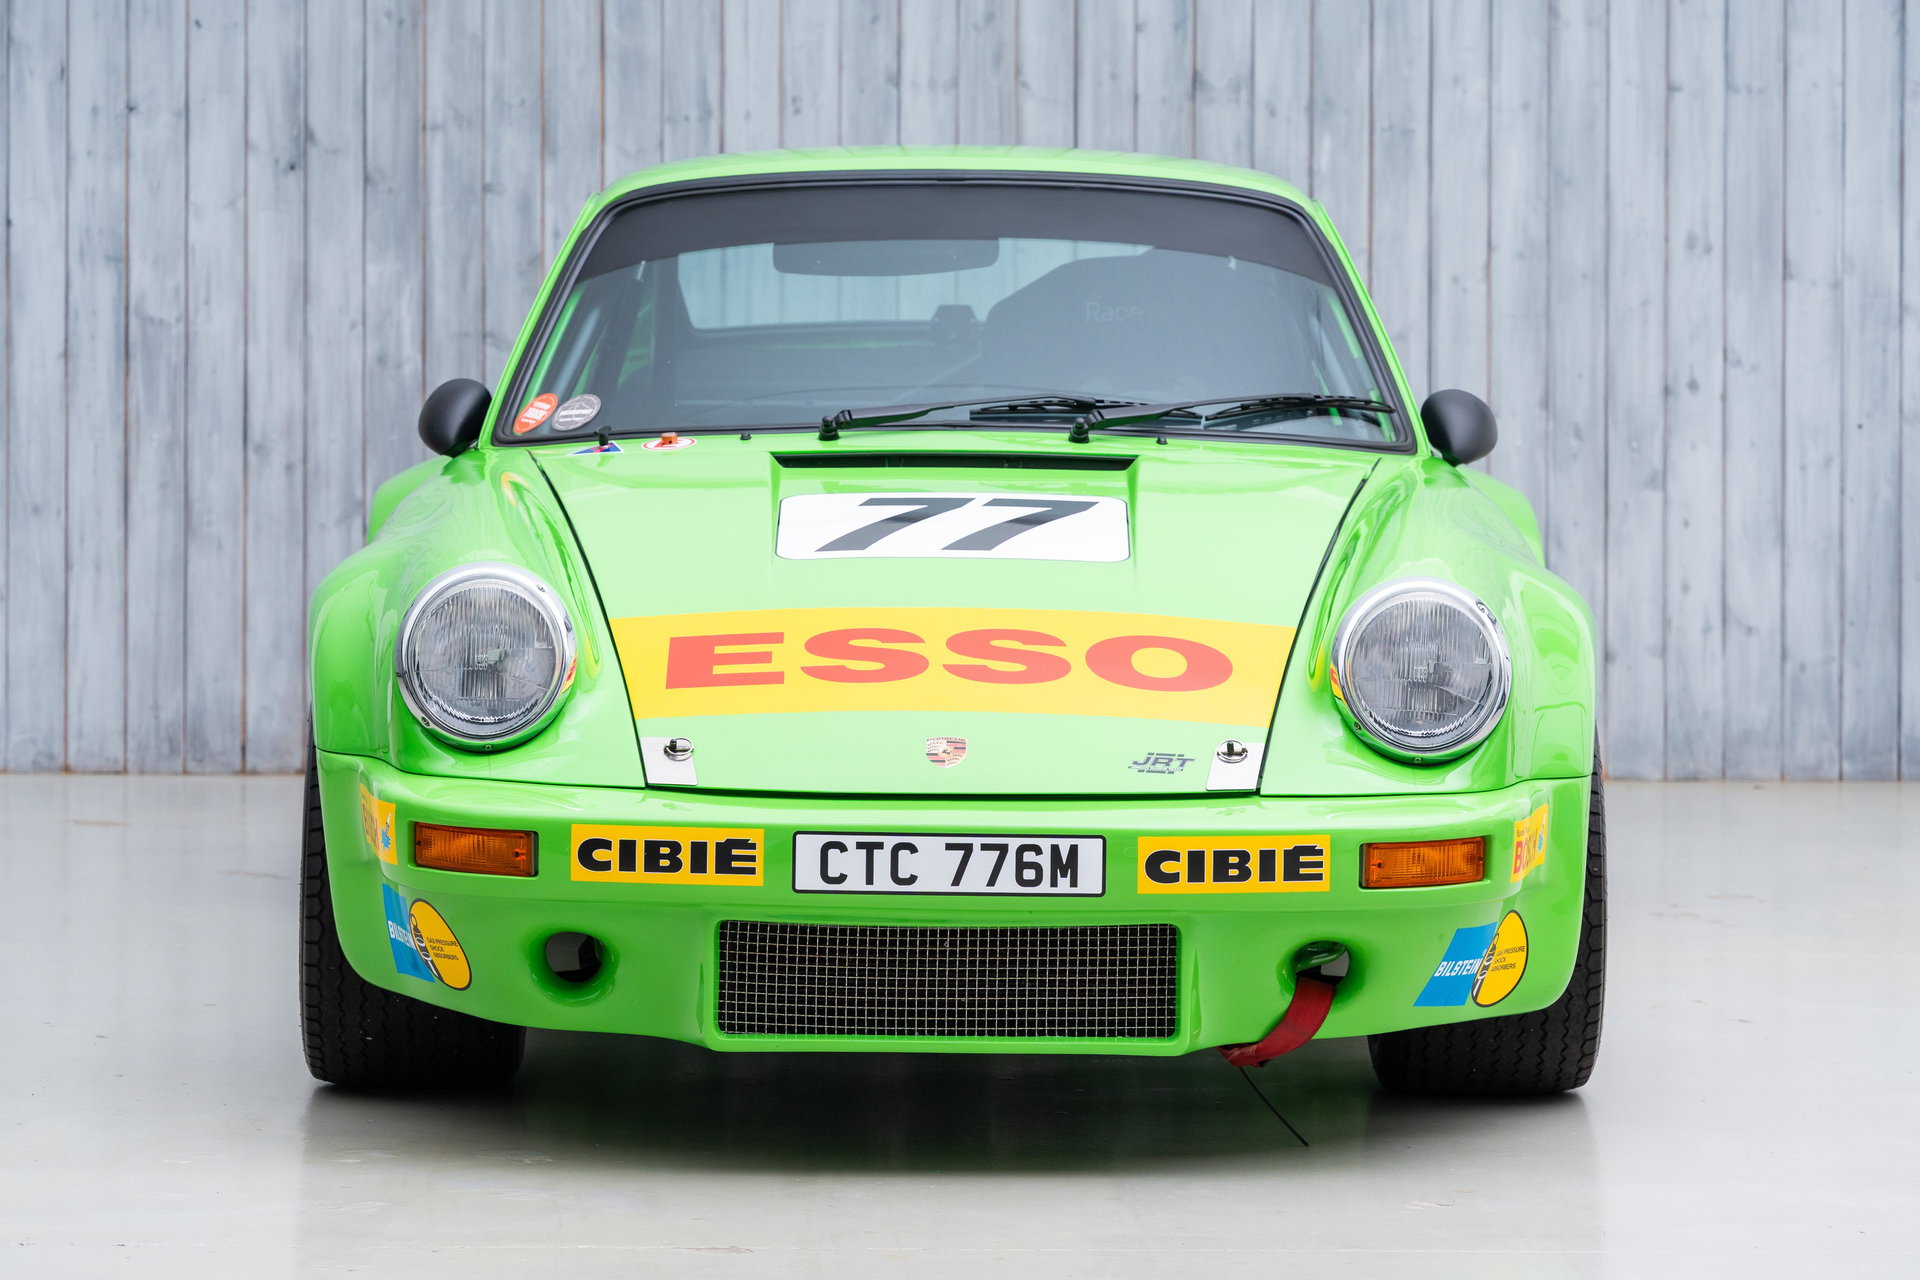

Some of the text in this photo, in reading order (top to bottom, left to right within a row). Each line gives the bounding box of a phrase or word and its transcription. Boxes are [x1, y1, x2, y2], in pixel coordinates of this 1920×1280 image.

[813, 496, 1100, 553] 77
[665, 627, 1233, 692] ESSO
[1132, 756, 1195, 768] JRT
[577, 837, 757, 875] CIBIÉ
[819, 840, 1079, 888] CTC 776M
[1144, 844, 1324, 884] CIBIÉ
[387, 920, 417, 951] BILSTEIN
[1504, 945, 1526, 955] PRESSURE
[1433, 957, 1484, 977] BILSTEIN
[1490, 962, 1517, 972] ABSORBERS
